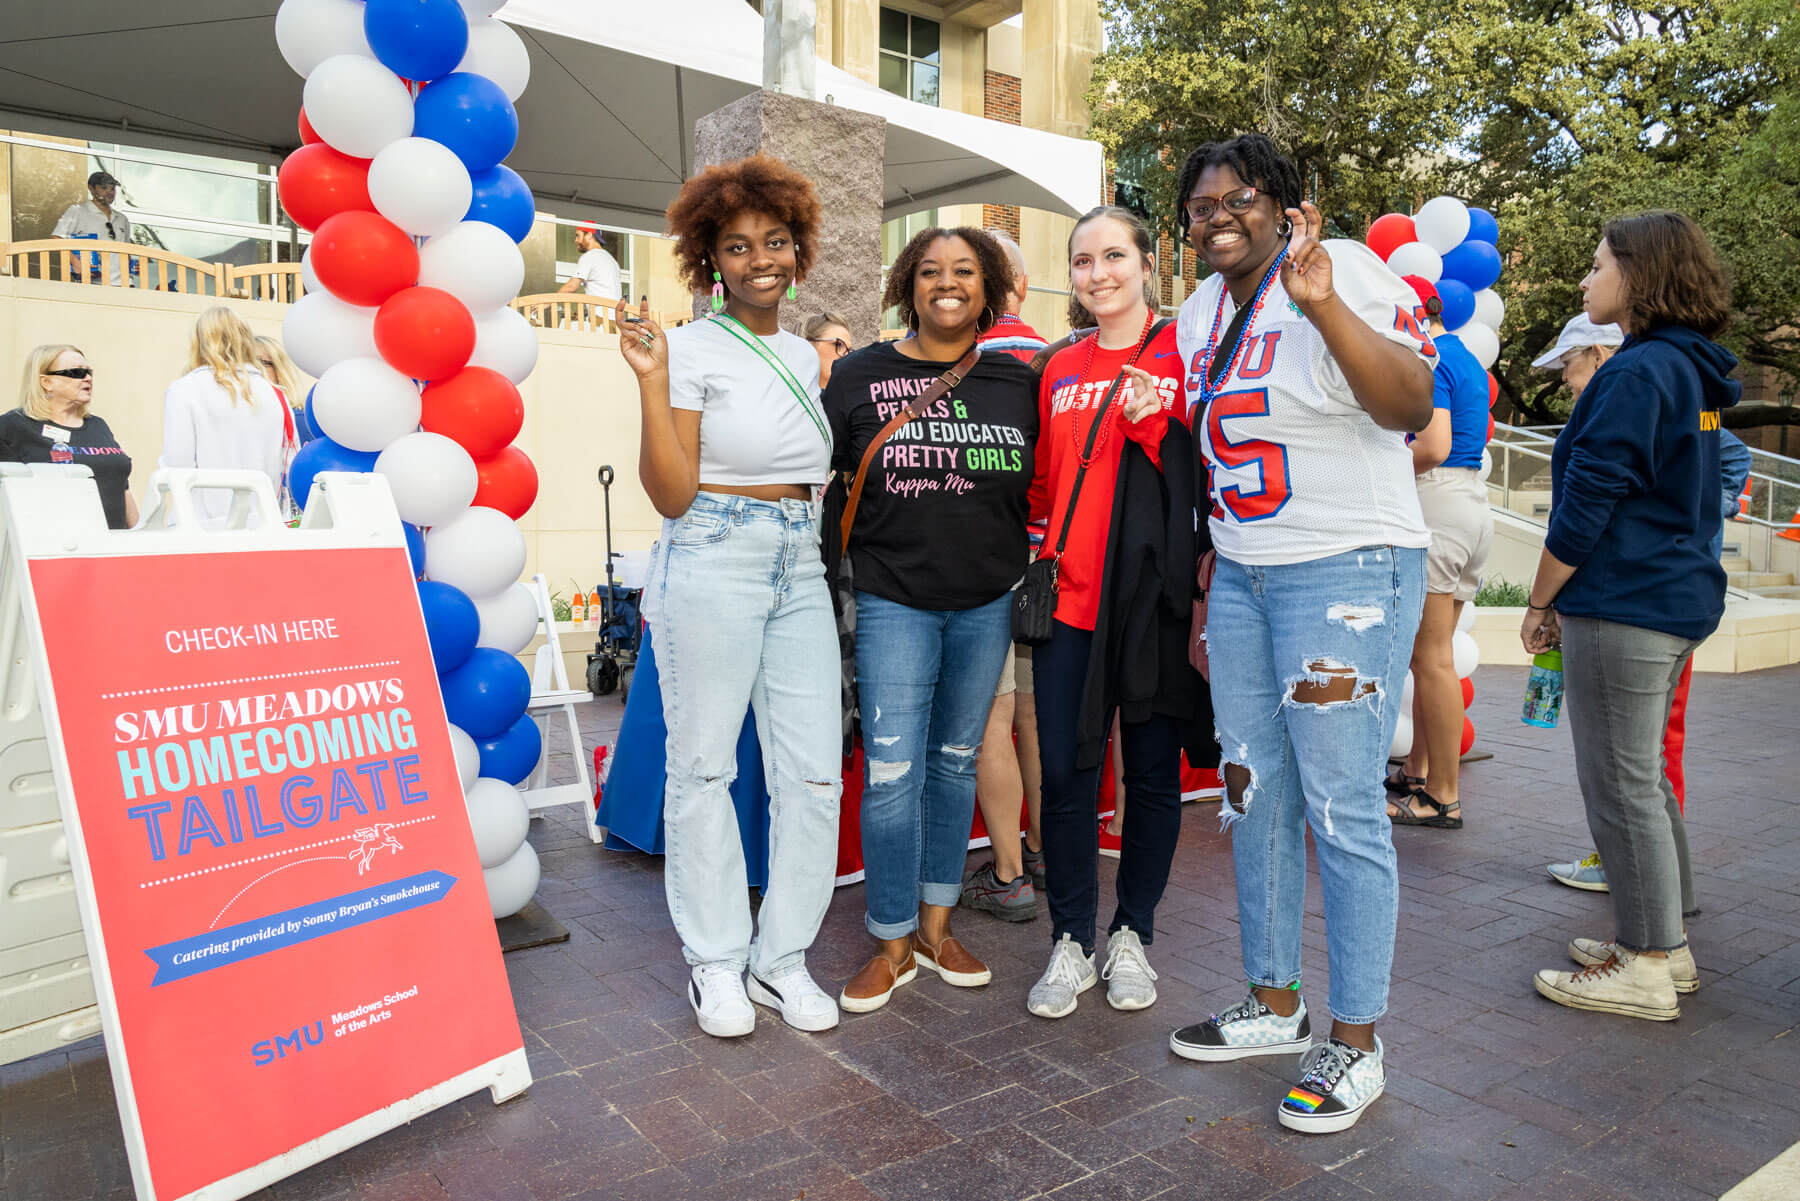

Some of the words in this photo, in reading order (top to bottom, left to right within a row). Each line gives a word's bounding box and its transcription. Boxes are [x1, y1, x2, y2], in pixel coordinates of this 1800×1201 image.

[1186, 330, 1282, 392] SU
[876, 400, 950, 422] PEALS
[953, 400, 968, 419] &
[1051, 375, 1179, 420] MUSTNS
[70, 446, 126, 456] EADOW
[930, 423, 1025, 446] EDUCATED
[882, 445, 959, 469] PRETTY
[966, 449, 1023, 472] GIRLS
[886, 473, 941, 498] Kappa
[945, 474, 976, 495] Mu
[165, 624, 278, 653] CHECK-IN
[283, 618, 339, 643] HERE
[115, 704, 208, 742] SMU
[217, 678, 404, 729] MEADOWS
[117, 708, 418, 799] HOMECOMING
[127, 754, 428, 861] TAILGATE
[173, 941, 230, 965] Catering
[231, 923, 285, 951] provided
[287, 920, 302, 933] by
[303, 910, 337, 928] Sonny
[380, 880, 440, 904] Smokehouse
[331, 1000, 383, 1025] Meadows
[383, 985, 419, 1006] School
[334, 1024, 347, 1037] of
[348, 1019, 367, 1032] the
[369, 1010, 392, 1024] Arts
[251, 1020, 324, 1067] SMU
